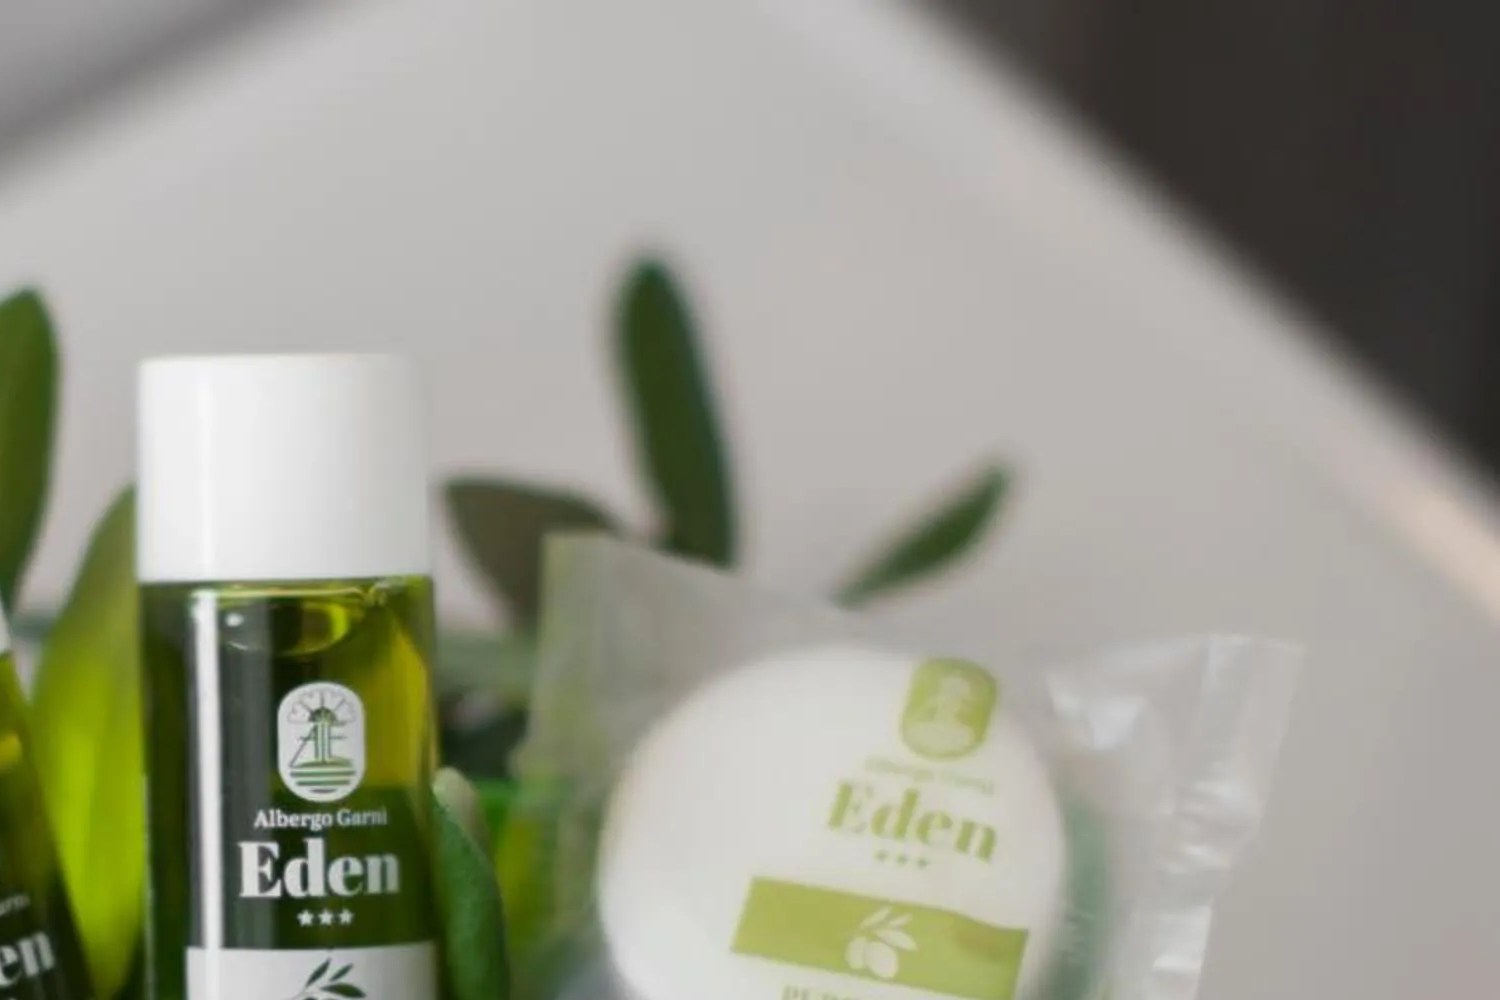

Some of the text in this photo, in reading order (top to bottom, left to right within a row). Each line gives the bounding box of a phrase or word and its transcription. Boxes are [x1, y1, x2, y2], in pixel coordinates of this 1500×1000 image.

[254, 808, 333, 831] Albergo
[827, 779, 997, 862] Eden
[237, 837, 400, 898] Eden
